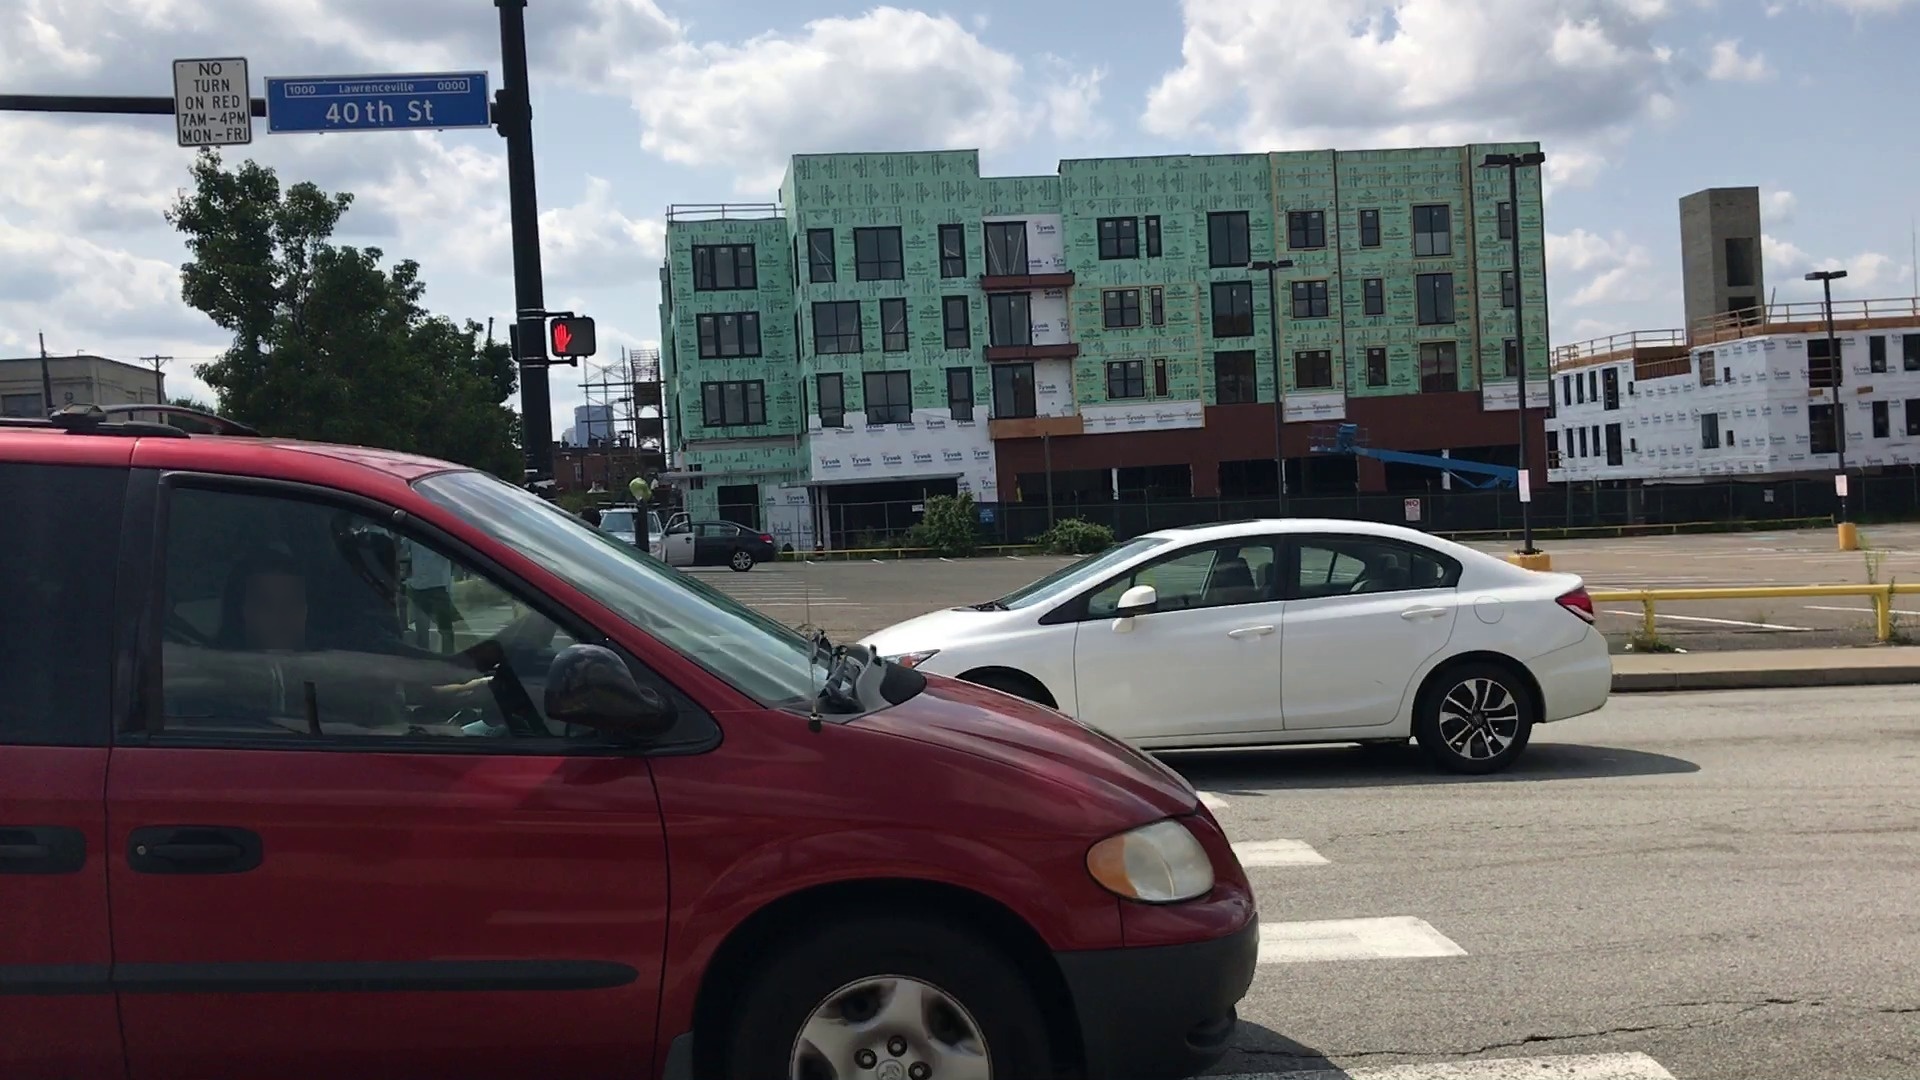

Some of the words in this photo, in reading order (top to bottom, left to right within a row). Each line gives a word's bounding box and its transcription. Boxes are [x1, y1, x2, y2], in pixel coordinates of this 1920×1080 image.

[198, 62, 222, 76] NO
[194, 79, 230, 93] TURN
[288, 85, 316, 95] 1000
[338, 82, 414, 94] Lawrenceville
[437, 80, 466, 91] 0000
[185, 96, 204, 110] ON
[212, 95, 240, 109] RED
[325, 99, 394, 124] 40th
[407, 99, 434, 122] St
